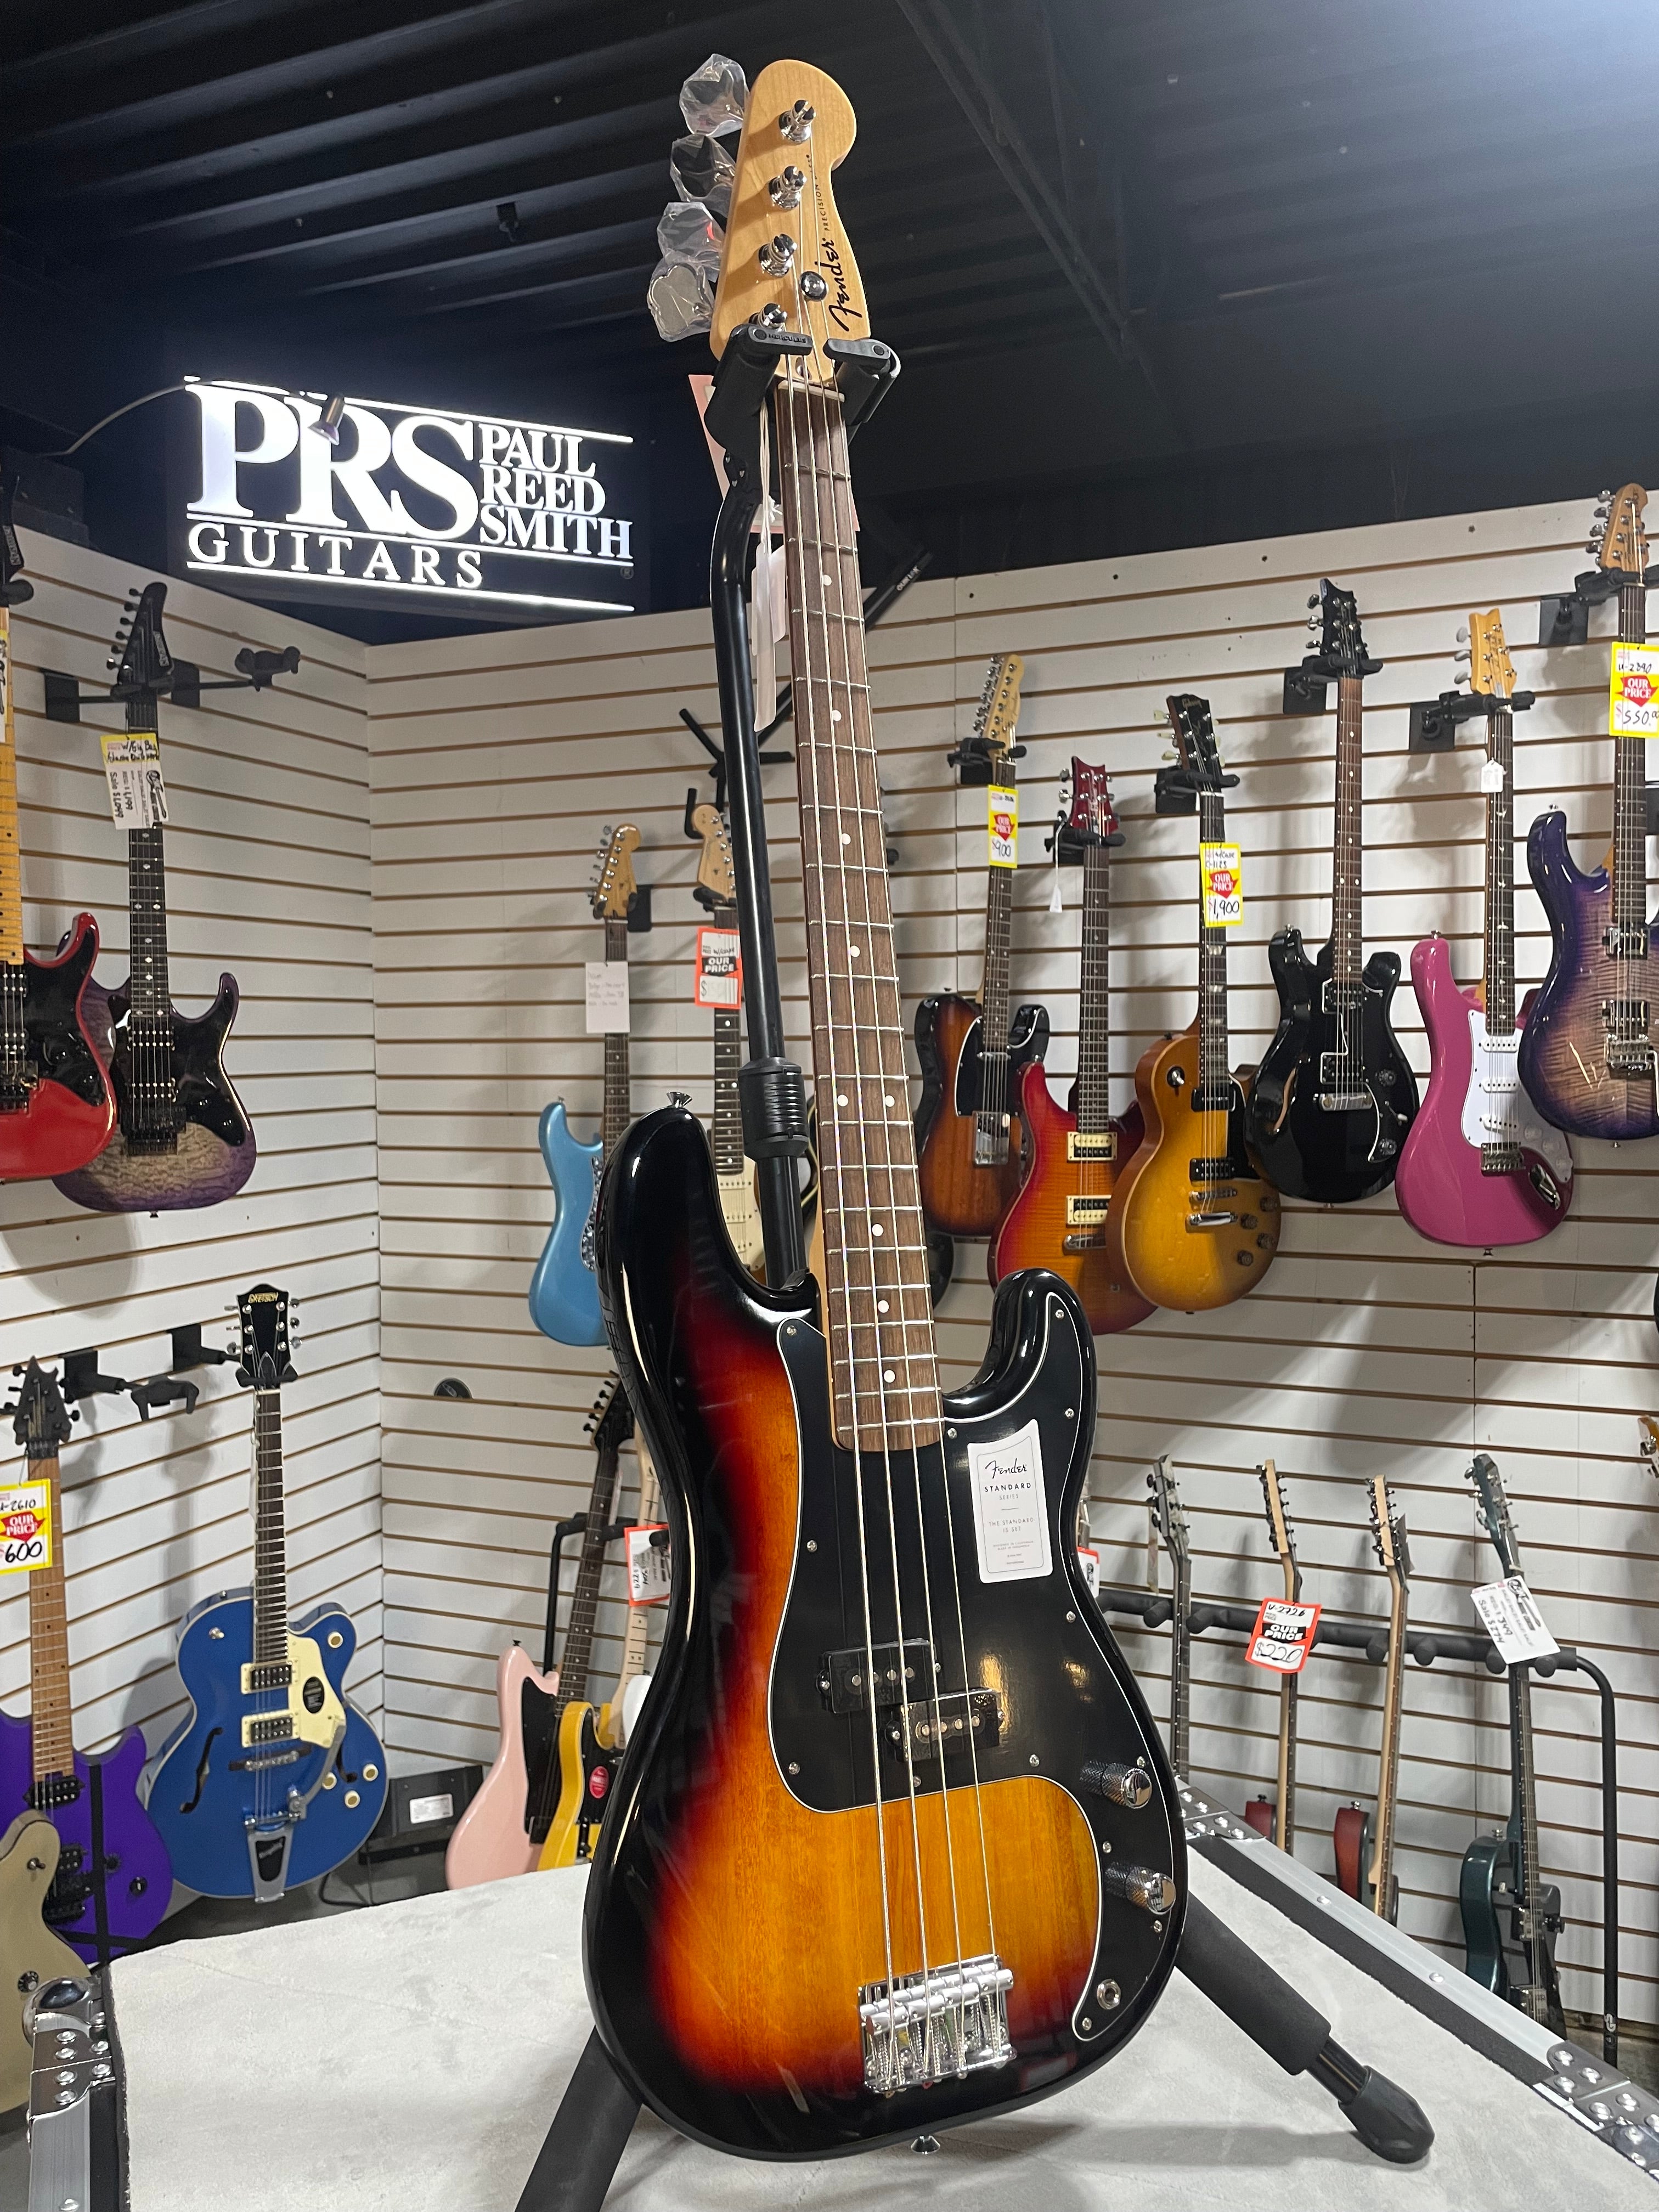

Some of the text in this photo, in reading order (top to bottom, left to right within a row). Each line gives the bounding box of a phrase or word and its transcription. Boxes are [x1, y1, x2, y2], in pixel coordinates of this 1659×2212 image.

[815, 239, 862, 332] Fender
[478, 422, 596, 478] PAUL
[184, 383, 479, 540] PRS
[479, 463, 606, 516] REED
[479, 505, 634, 560] SMITH
[188, 522, 483, 589] GUITARS
[1627, 678, 1649, 689] OUR
[1624, 687, 1652, 699] PRICE
[1214, 873, 1231, 883] OUR
[1212, 882, 1233, 891] PRICE
[705, 963, 734, 973] PRICE
[984, 1458, 1027, 1479] Fender
[984, 1482, 1032, 1492] STANDARD
[9, 1514, 34, 1527] OUR
[1002, 1517, 1034, 1525] STANDARD
[6, 1523, 38, 1536] PRICE
[1264, 1629, 1304, 1640] PRICE
[1270, 1624, 1299, 1634] OUR
[1255, 1641, 1303, 1663] $220
